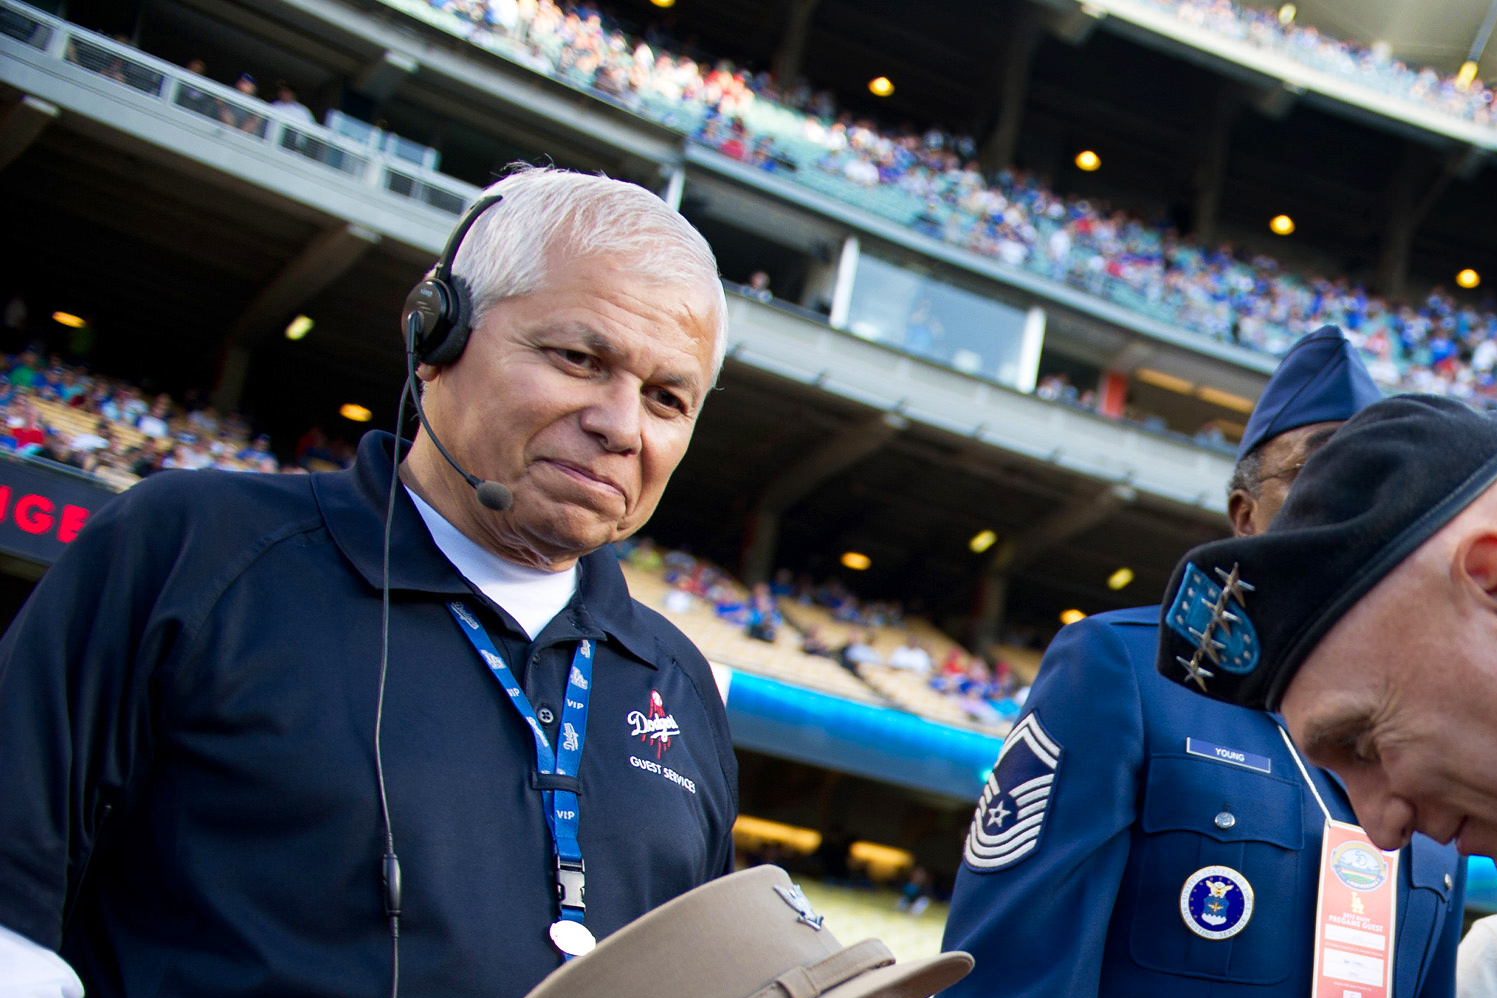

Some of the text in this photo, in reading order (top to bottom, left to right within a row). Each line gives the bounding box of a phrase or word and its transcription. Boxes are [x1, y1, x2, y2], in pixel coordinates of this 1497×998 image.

[566, 698, 584, 710] VIP
[627, 710, 680, 742] Dodgers
[1215, 747, 1245, 762] YOUNG
[629, 755, 662, 774] GUEST
[556, 809, 575, 820] VIP
[1328, 914, 1383, 932] PREGAME GUEST
